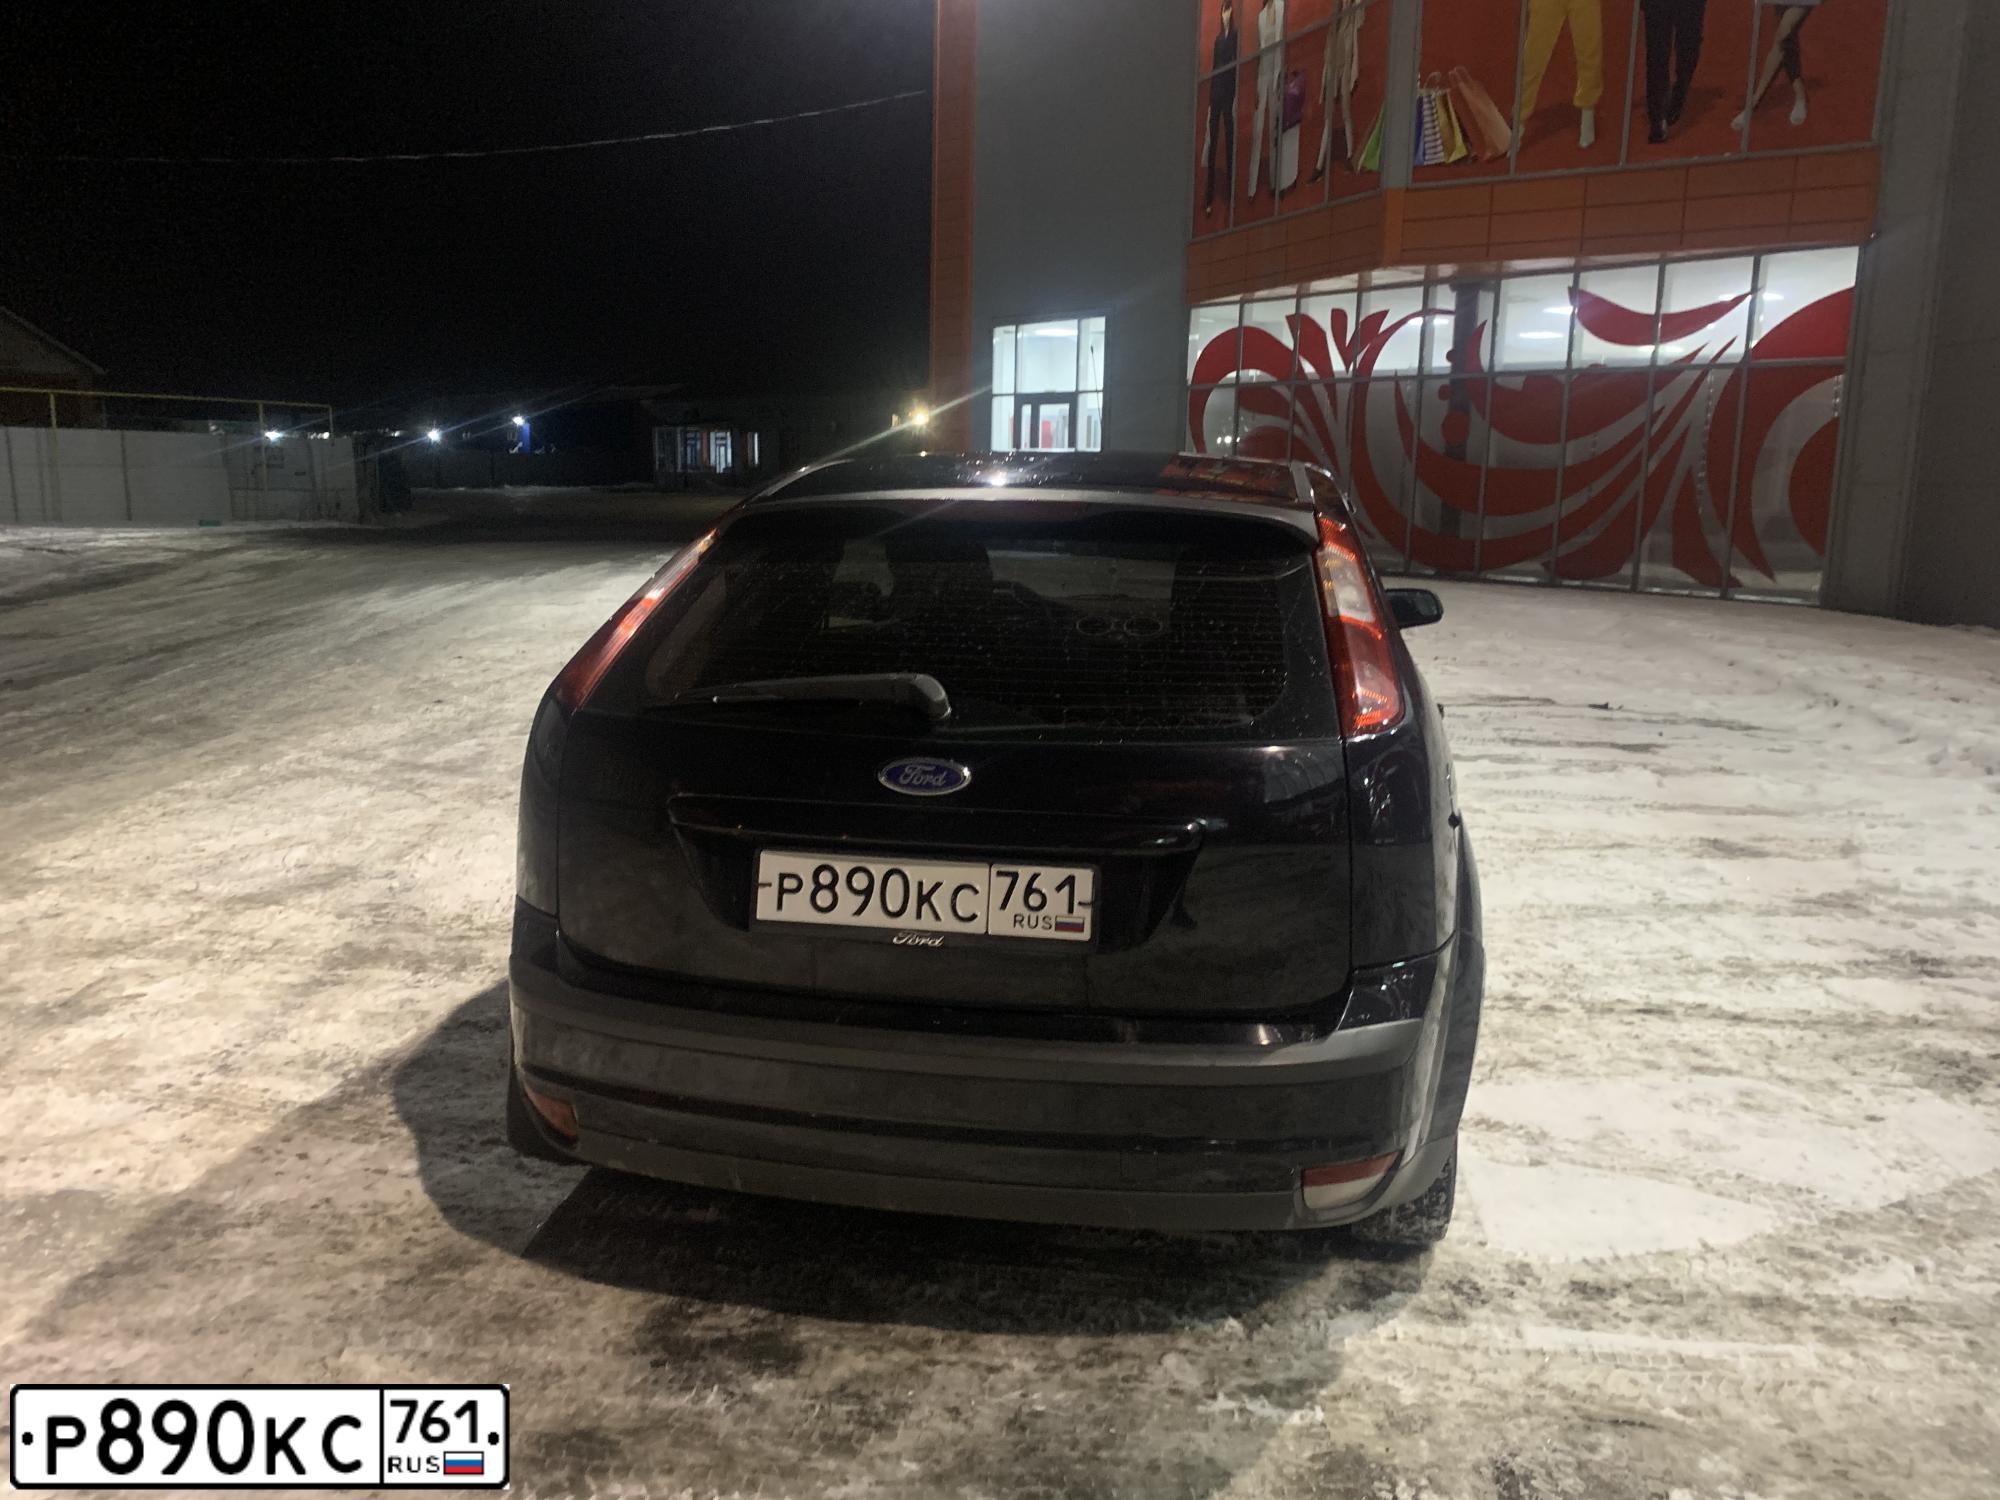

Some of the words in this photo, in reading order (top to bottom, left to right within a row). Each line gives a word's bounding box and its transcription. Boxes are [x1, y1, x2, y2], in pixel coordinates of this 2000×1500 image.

[899, 764, 948, 787] Ford
[996, 870, 1076, 915] 761
[1013, 913, 1053, 931] RUS
[892, 931, 945, 947] Ford
